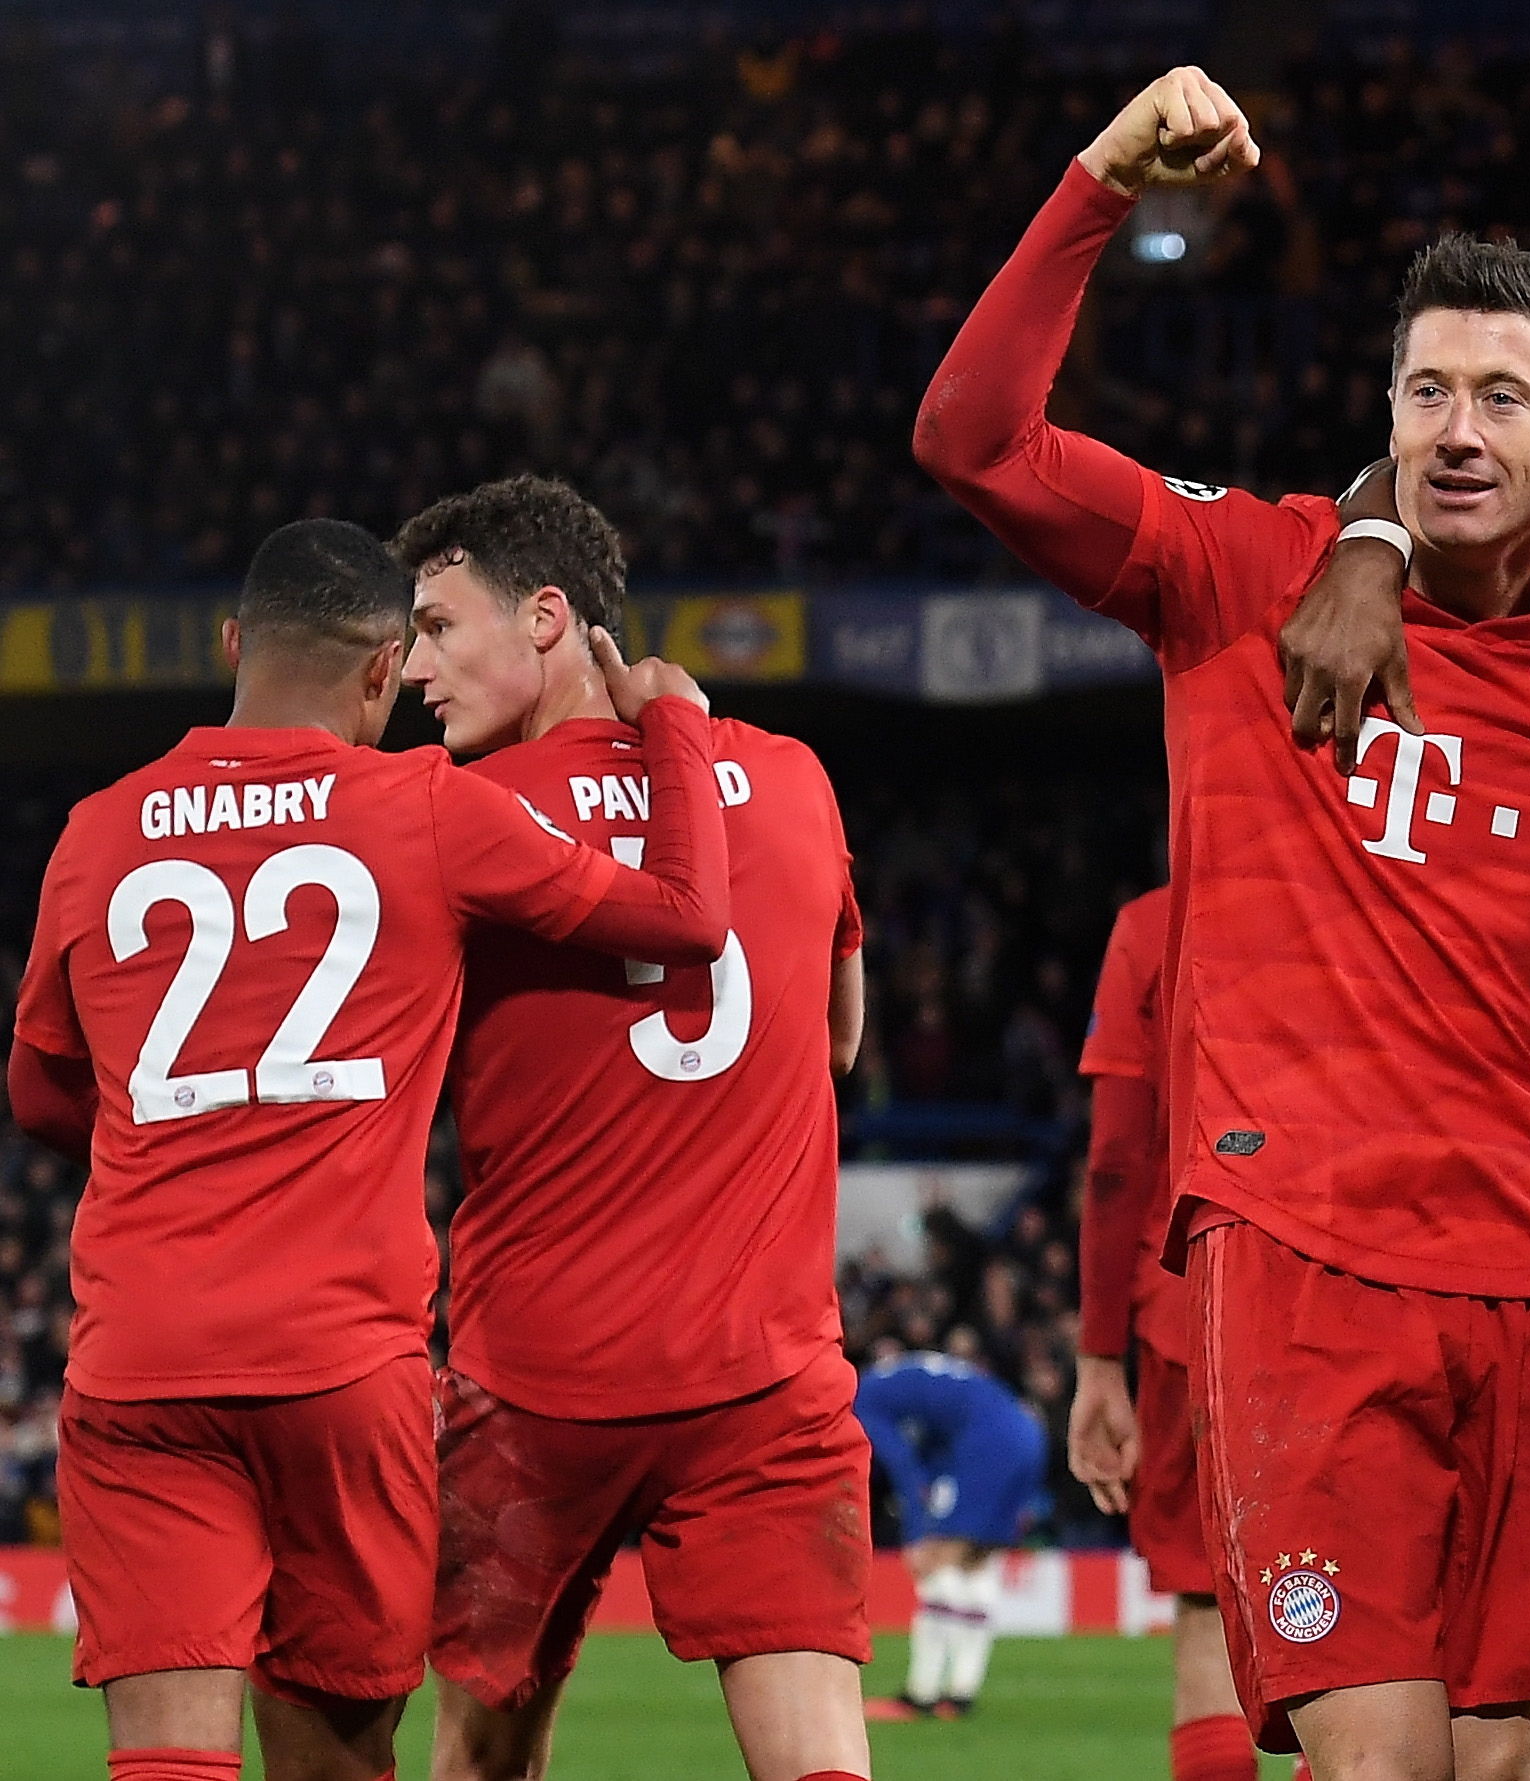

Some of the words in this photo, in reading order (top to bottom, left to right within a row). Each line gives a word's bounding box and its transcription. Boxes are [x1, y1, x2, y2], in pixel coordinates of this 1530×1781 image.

[141, 774, 336, 839] GNABRY
[569, 760, 752, 822] PAVD
[107, 844, 387, 1125] 22
[1284, 1575, 1331, 1599] BAYERN
